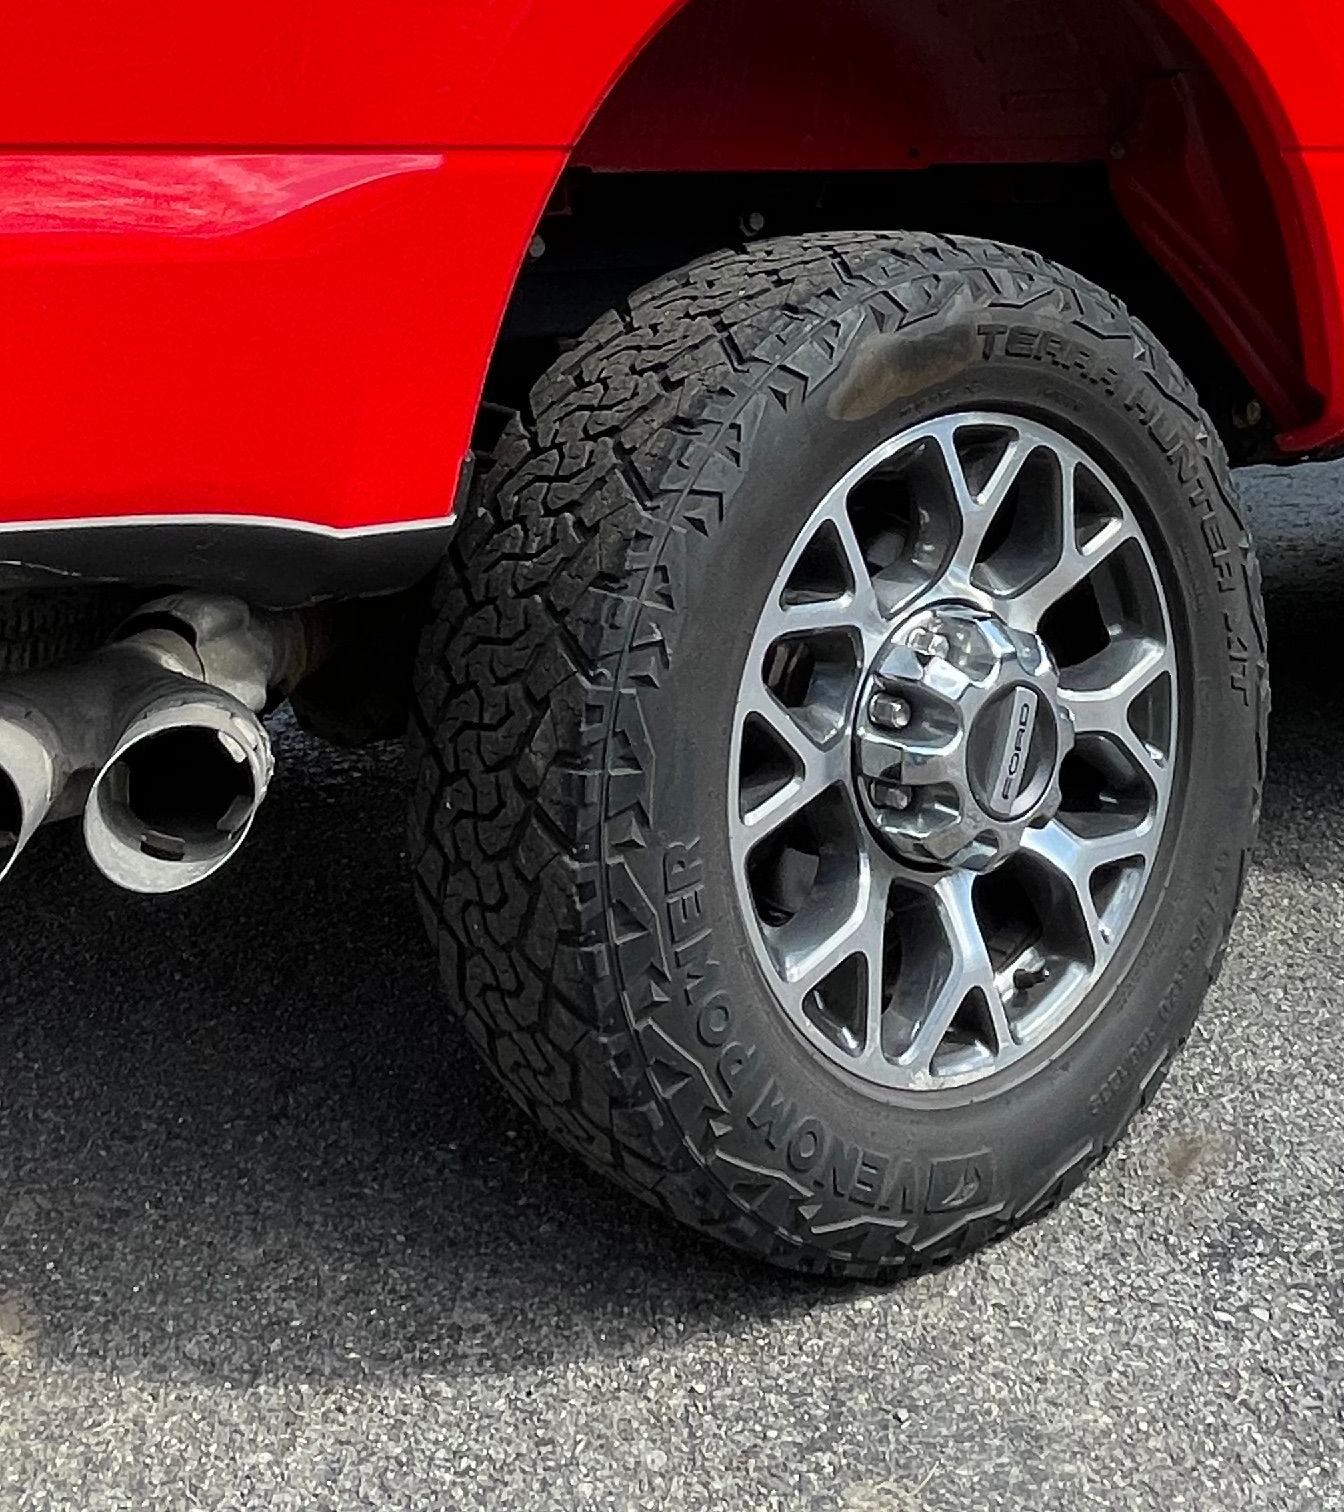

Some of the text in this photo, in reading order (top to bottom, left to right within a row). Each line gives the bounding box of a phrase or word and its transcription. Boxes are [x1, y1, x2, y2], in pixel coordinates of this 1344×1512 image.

[977, 323, 1120, 397] TERRA
[1123, 393, 1235, 593] HUNTER
[1002, 702, 1030, 800] FORD
[662, 836, 920, 1214] VENOM POWER
